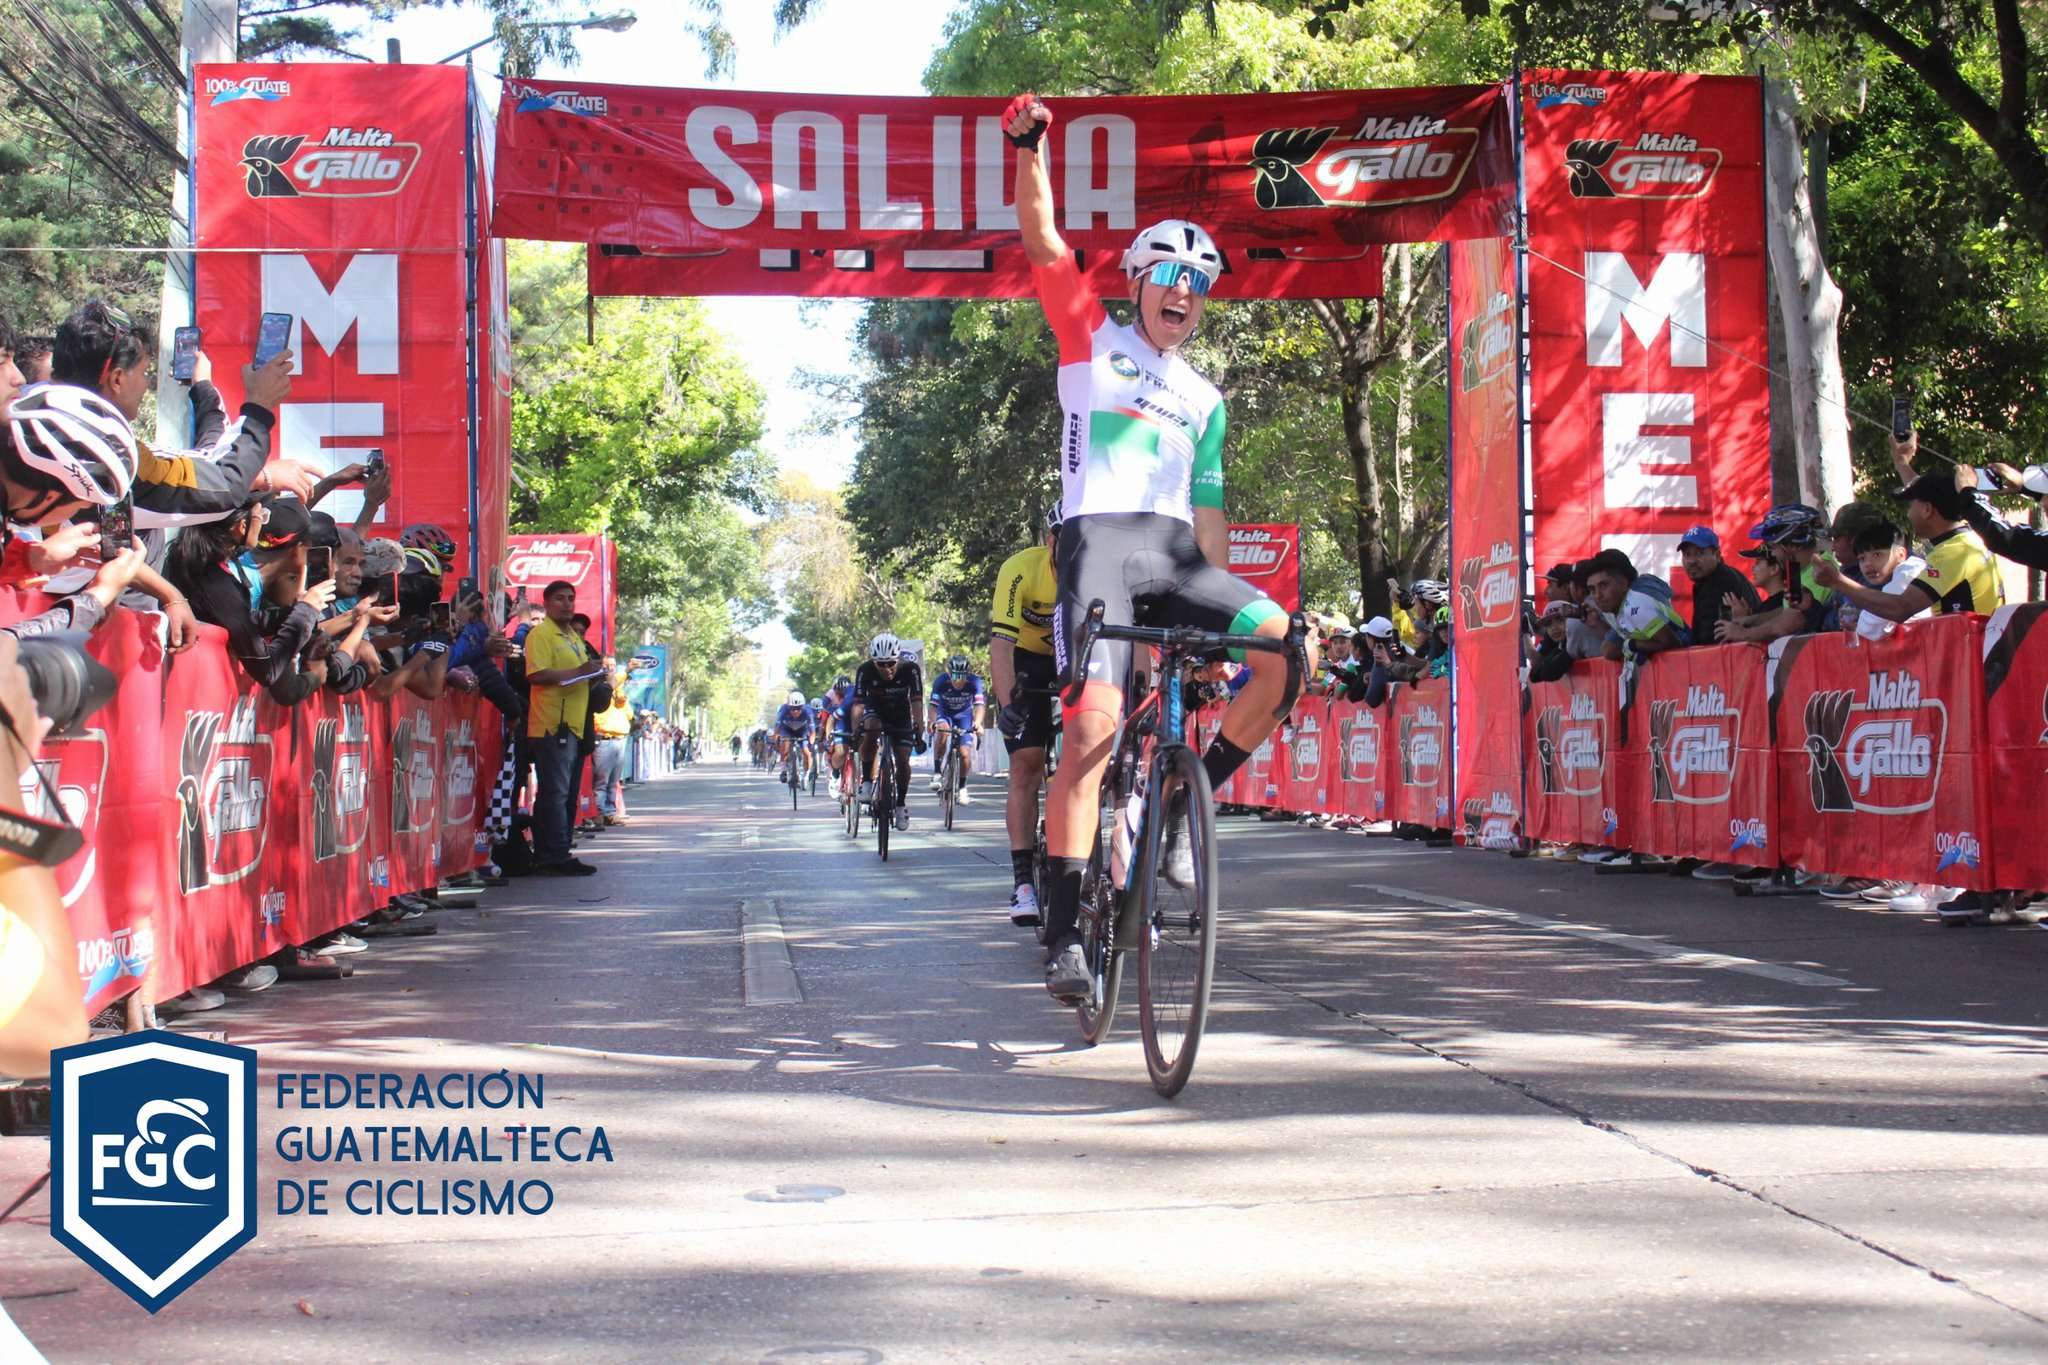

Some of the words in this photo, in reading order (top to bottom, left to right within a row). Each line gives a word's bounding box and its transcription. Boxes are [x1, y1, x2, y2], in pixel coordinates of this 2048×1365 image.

[205, 78, 239, 94] 100%
[239, 77, 290, 97] GUATE!
[321, 128, 393, 147] Malta
[1353, 116, 1448, 141] Malta
[1634, 133, 1698, 152] Malta
[293, 151, 402, 188] Gallo
[1315, 142, 1455, 197] Gallo
[1609, 155, 1705, 191] Gallo
[528, 541, 576, 554] Malta
[1229, 529, 1271, 542] Malta
[508, 556, 581, 581] Gallo
[1490, 541, 1513, 567] Malta
[1480, 568, 1516, 618] Gallo
[1569, 694, 1596, 719] Malta
[1685, 684, 1725, 717] Malta
[1866, 669, 1922, 711] Malta
[1411, 733, 1440, 778] Gallo
[1560, 728, 1600, 782] Gallo
[1670, 725, 1730, 789] Gallo
[1846, 719, 1932, 796] Gallo
[204, 758, 265, 864] Gallo
